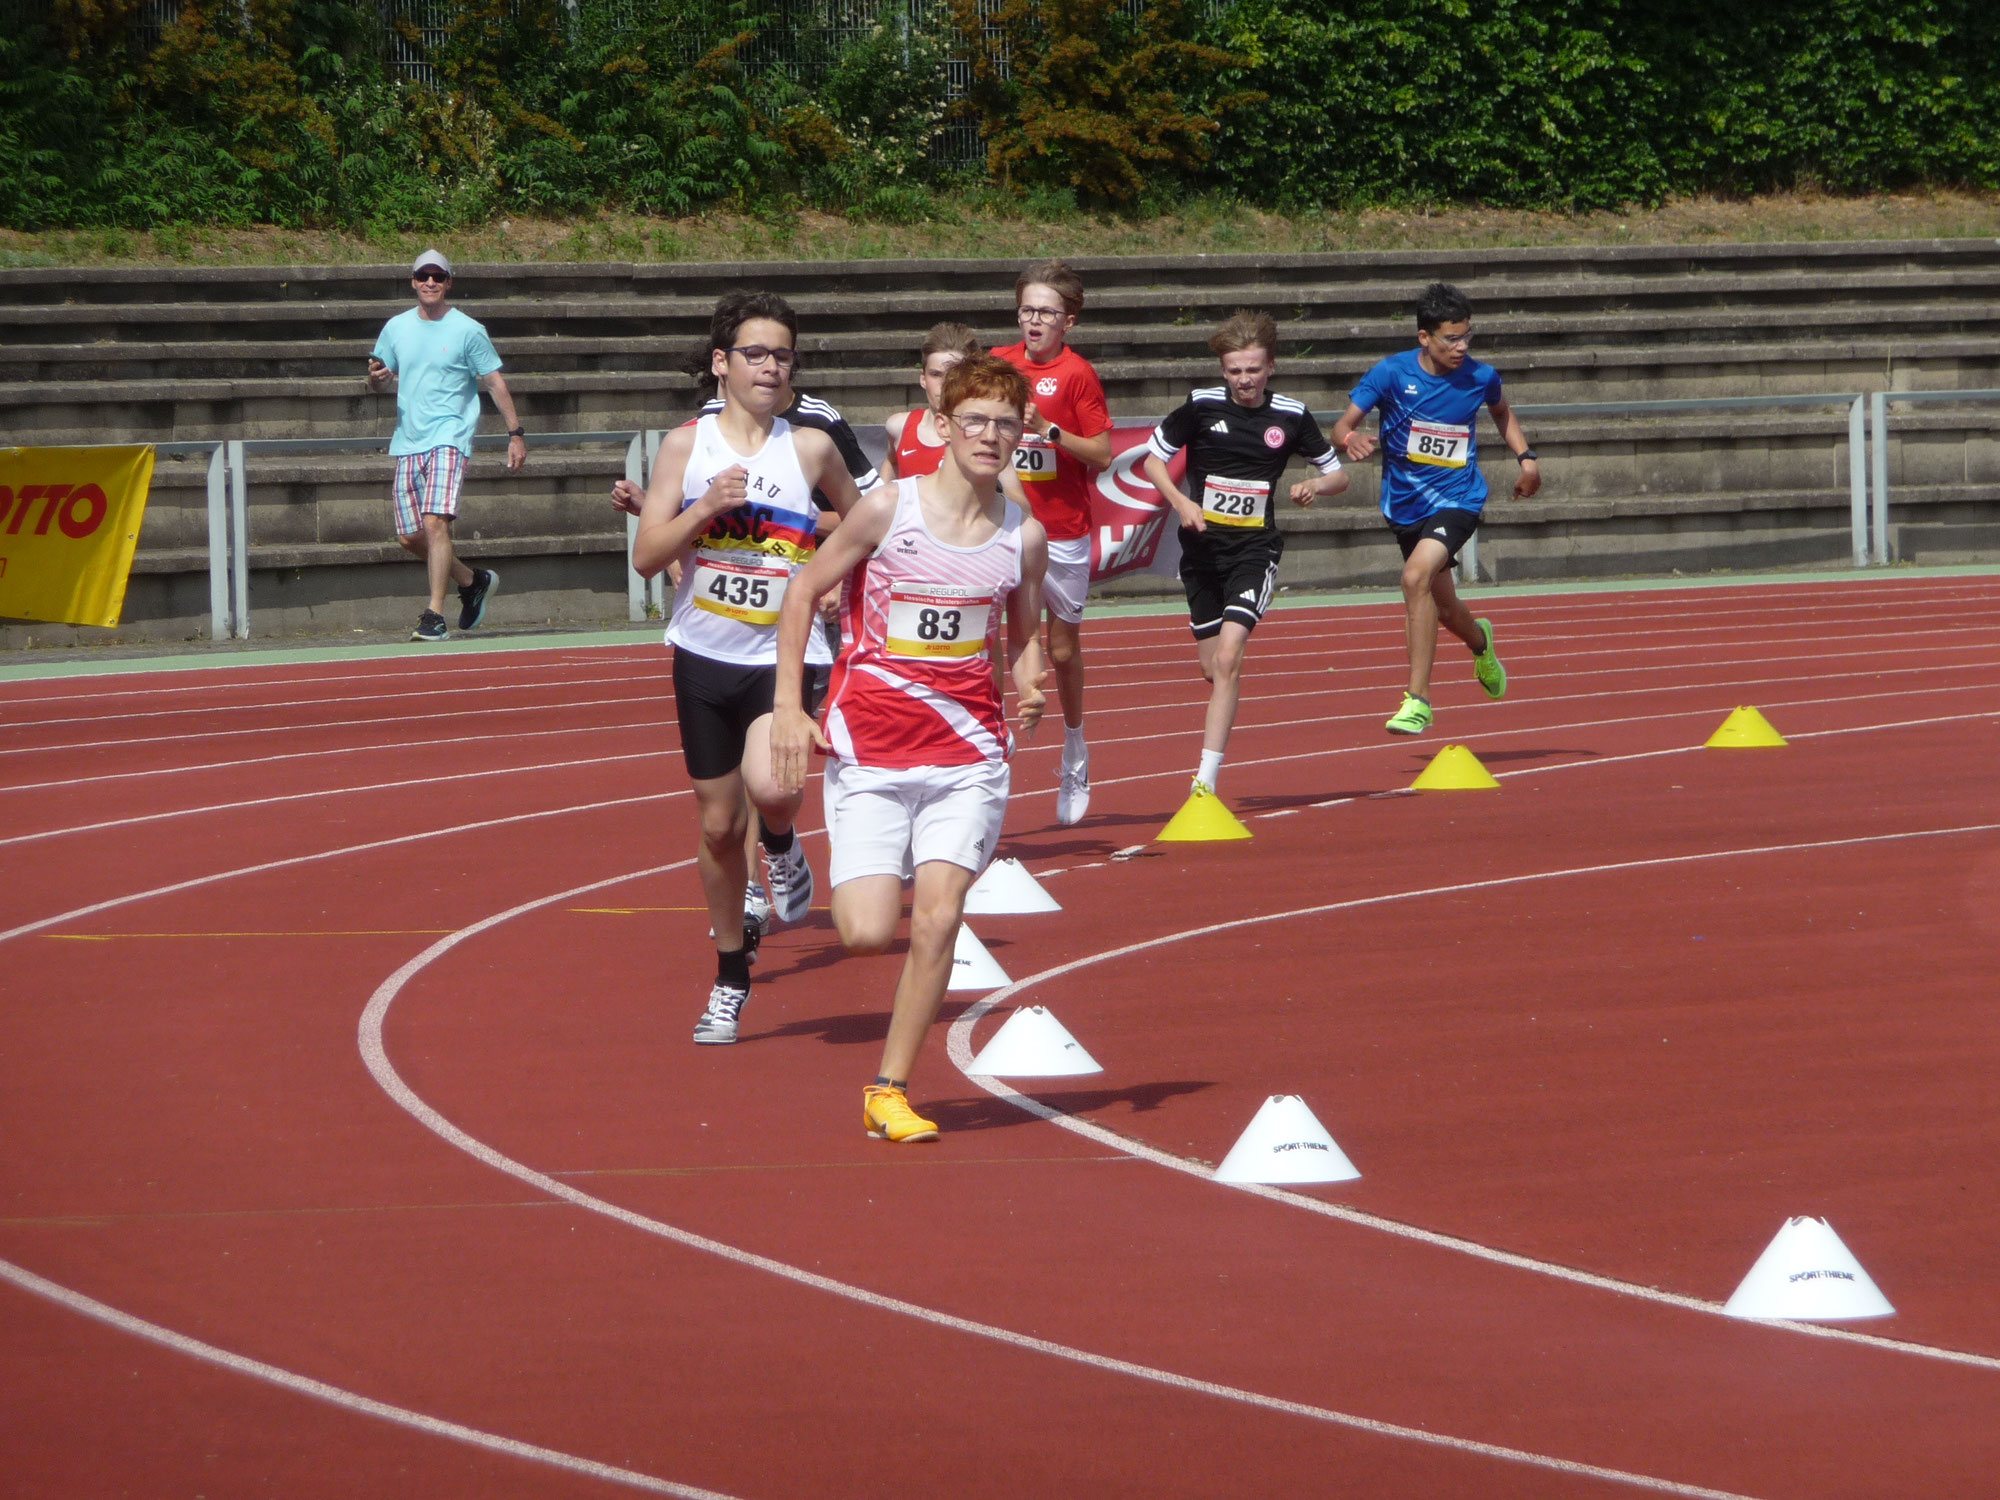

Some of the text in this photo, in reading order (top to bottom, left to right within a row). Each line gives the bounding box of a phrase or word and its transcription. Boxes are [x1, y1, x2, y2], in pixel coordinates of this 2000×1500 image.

[1418, 436, 1458, 458] 857
[1015, 449, 1043, 470] 20
[1213, 492, 1255, 515] 228
[1098, 517, 1162, 571] HLV
[709, 574, 769, 608] 435
[929, 588, 968, 597] REGUPOL
[917, 608, 961, 640] 83
[1273, 1142, 1329, 1153] SPORT-THIEME
[1789, 1270, 1855, 1283] SPORT-THIEME
